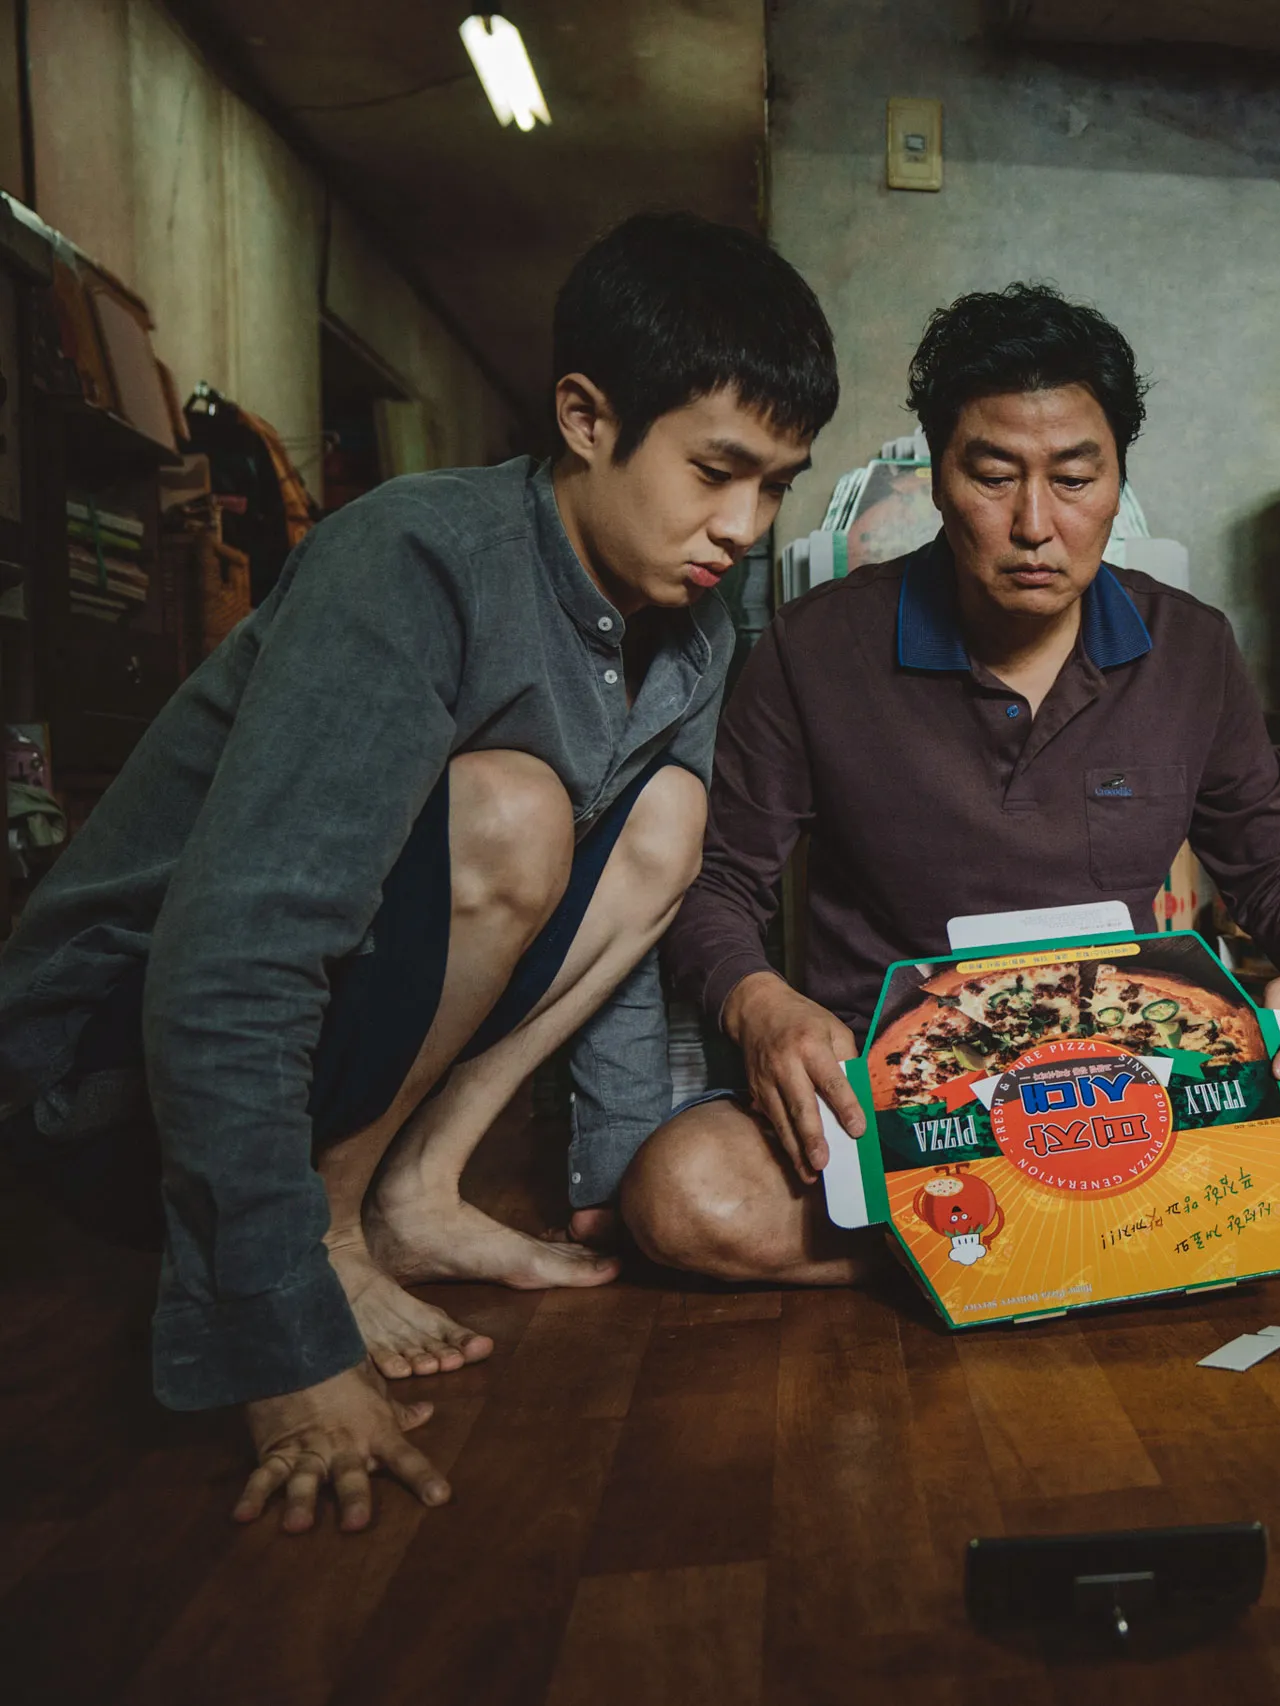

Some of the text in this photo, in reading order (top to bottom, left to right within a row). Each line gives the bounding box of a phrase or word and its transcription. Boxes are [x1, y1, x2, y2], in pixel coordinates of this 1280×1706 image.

[1008, 1050, 1043, 1078] PURE
[1049, 1042, 1097, 1053] PIZZA
[1118, 1053, 1158, 1087] SINCE
[1018, 1072, 1136, 1116] 시대
[1153, 1092, 1168, 1123] 2010
[1184, 1080, 1247, 1115] ITALY
[911, 1113, 979, 1152] PIZZA
[993, 1098, 1010, 1143] FRESH
[1023, 1114, 1152, 1157] 피자
[1017, 1158, 1123, 1191] GENERATION
[1128, 1139, 1164, 1176] PIZZA
[1203, 1166, 1254, 1206] 푸짐한
[1165, 1195, 1199, 1215] 양과
[1173, 1201, 1272, 1255] 신선한 재료와
